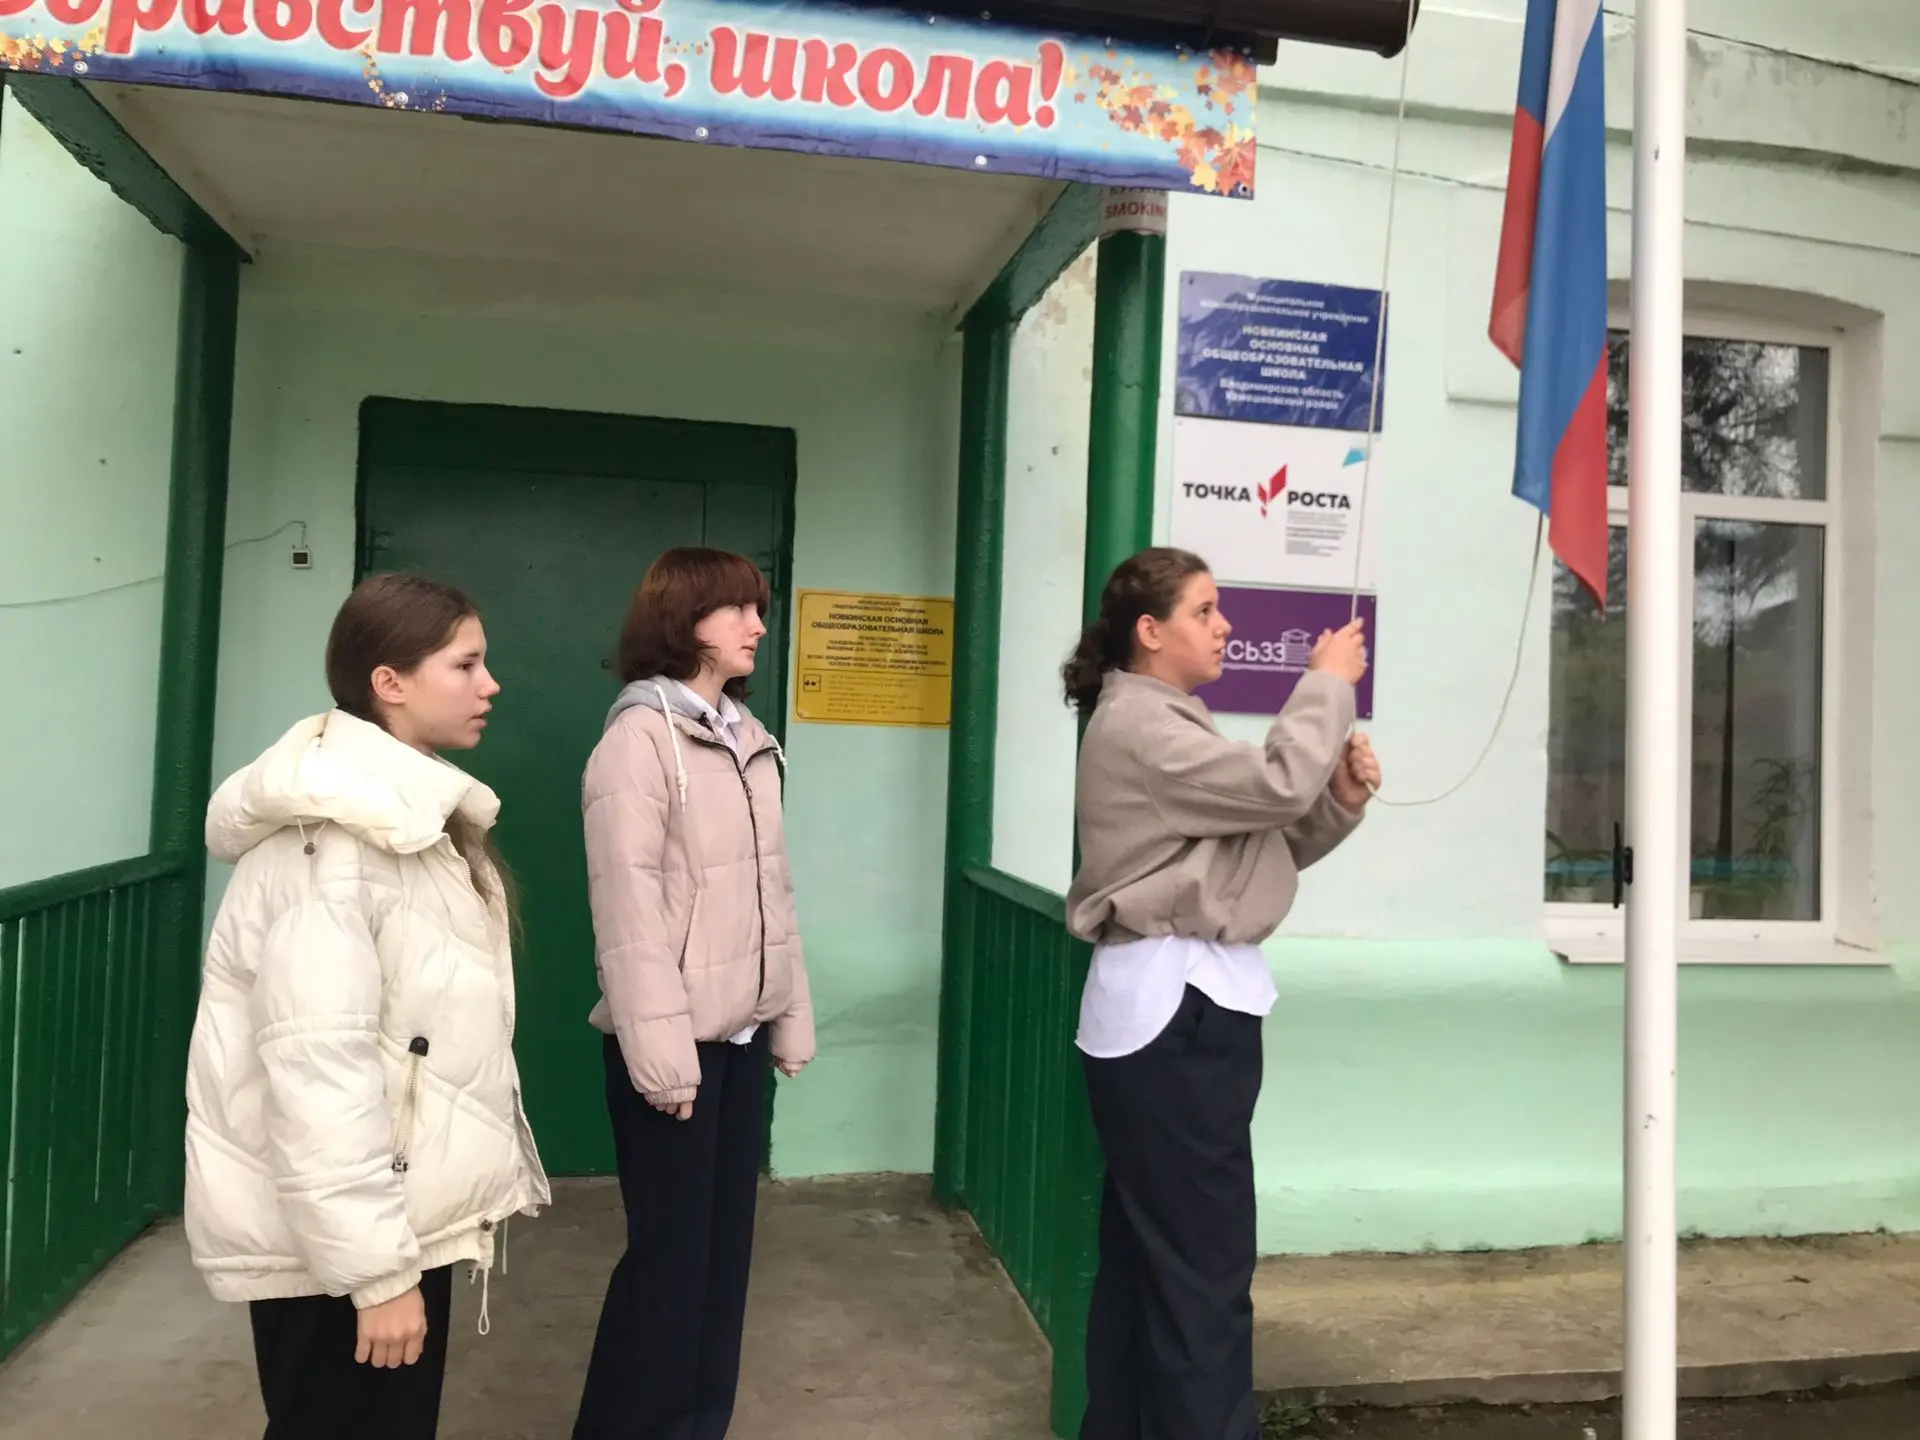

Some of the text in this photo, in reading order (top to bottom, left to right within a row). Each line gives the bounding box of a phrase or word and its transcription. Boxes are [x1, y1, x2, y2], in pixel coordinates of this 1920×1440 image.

[0, 0, 1064, 128] равствуй, школа!
[1104, 202, 1166, 219] SMOKIN
[1242, 325, 1328, 343] НОВКИНСКАЯ
[1249, 340, 1320, 355] ОСНОВНАЯ
[1202, 348, 1365, 373] ОБЩЕОБРАЗОВАТЕЛЬНАЯ
[1260, 366, 1307, 381] ШКОЛА
[1301, 386, 1345, 400] область
[1182, 483, 1351, 510] ТОЧКА РОСТА
[829, 613, 929, 625] НОВКИНСКАЯ ОСНОВНАЯ
[811, 621, 944, 636] ОБЩЕОБРАЗОВАТЕЛЬНАЯ ШКОЛА
